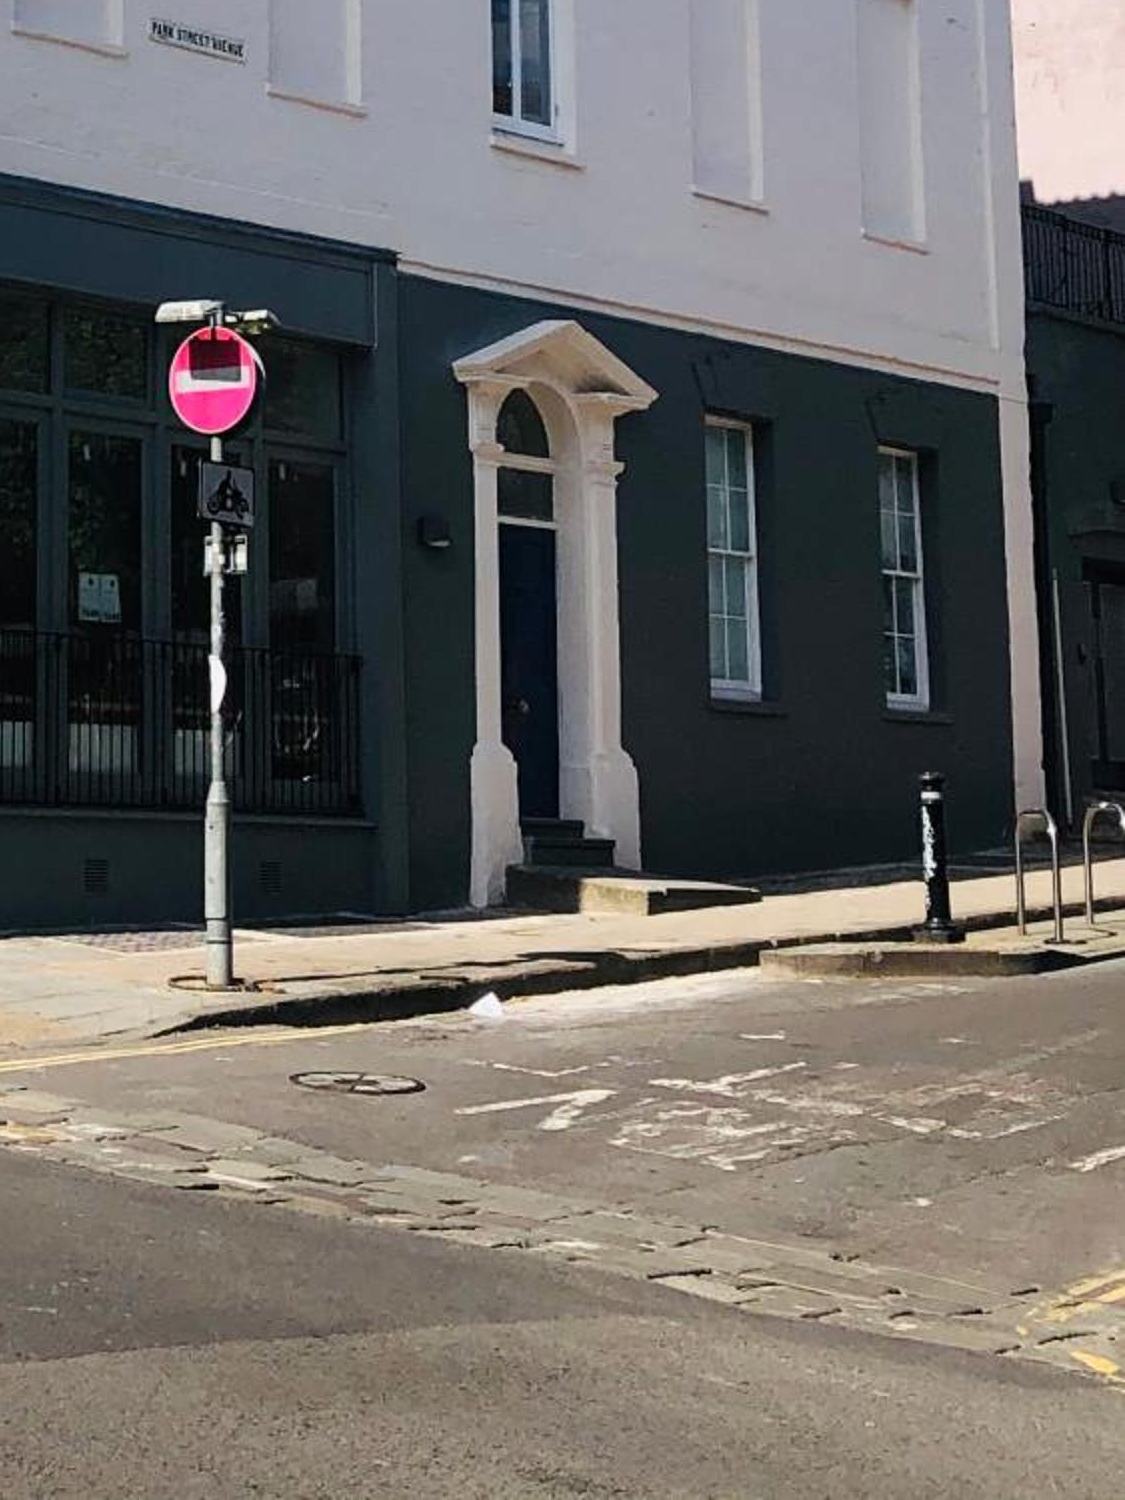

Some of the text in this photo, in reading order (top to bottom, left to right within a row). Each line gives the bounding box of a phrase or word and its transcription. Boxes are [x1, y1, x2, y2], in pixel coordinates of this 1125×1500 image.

[152, 21, 244, 57] PARK STREET AVENUE
